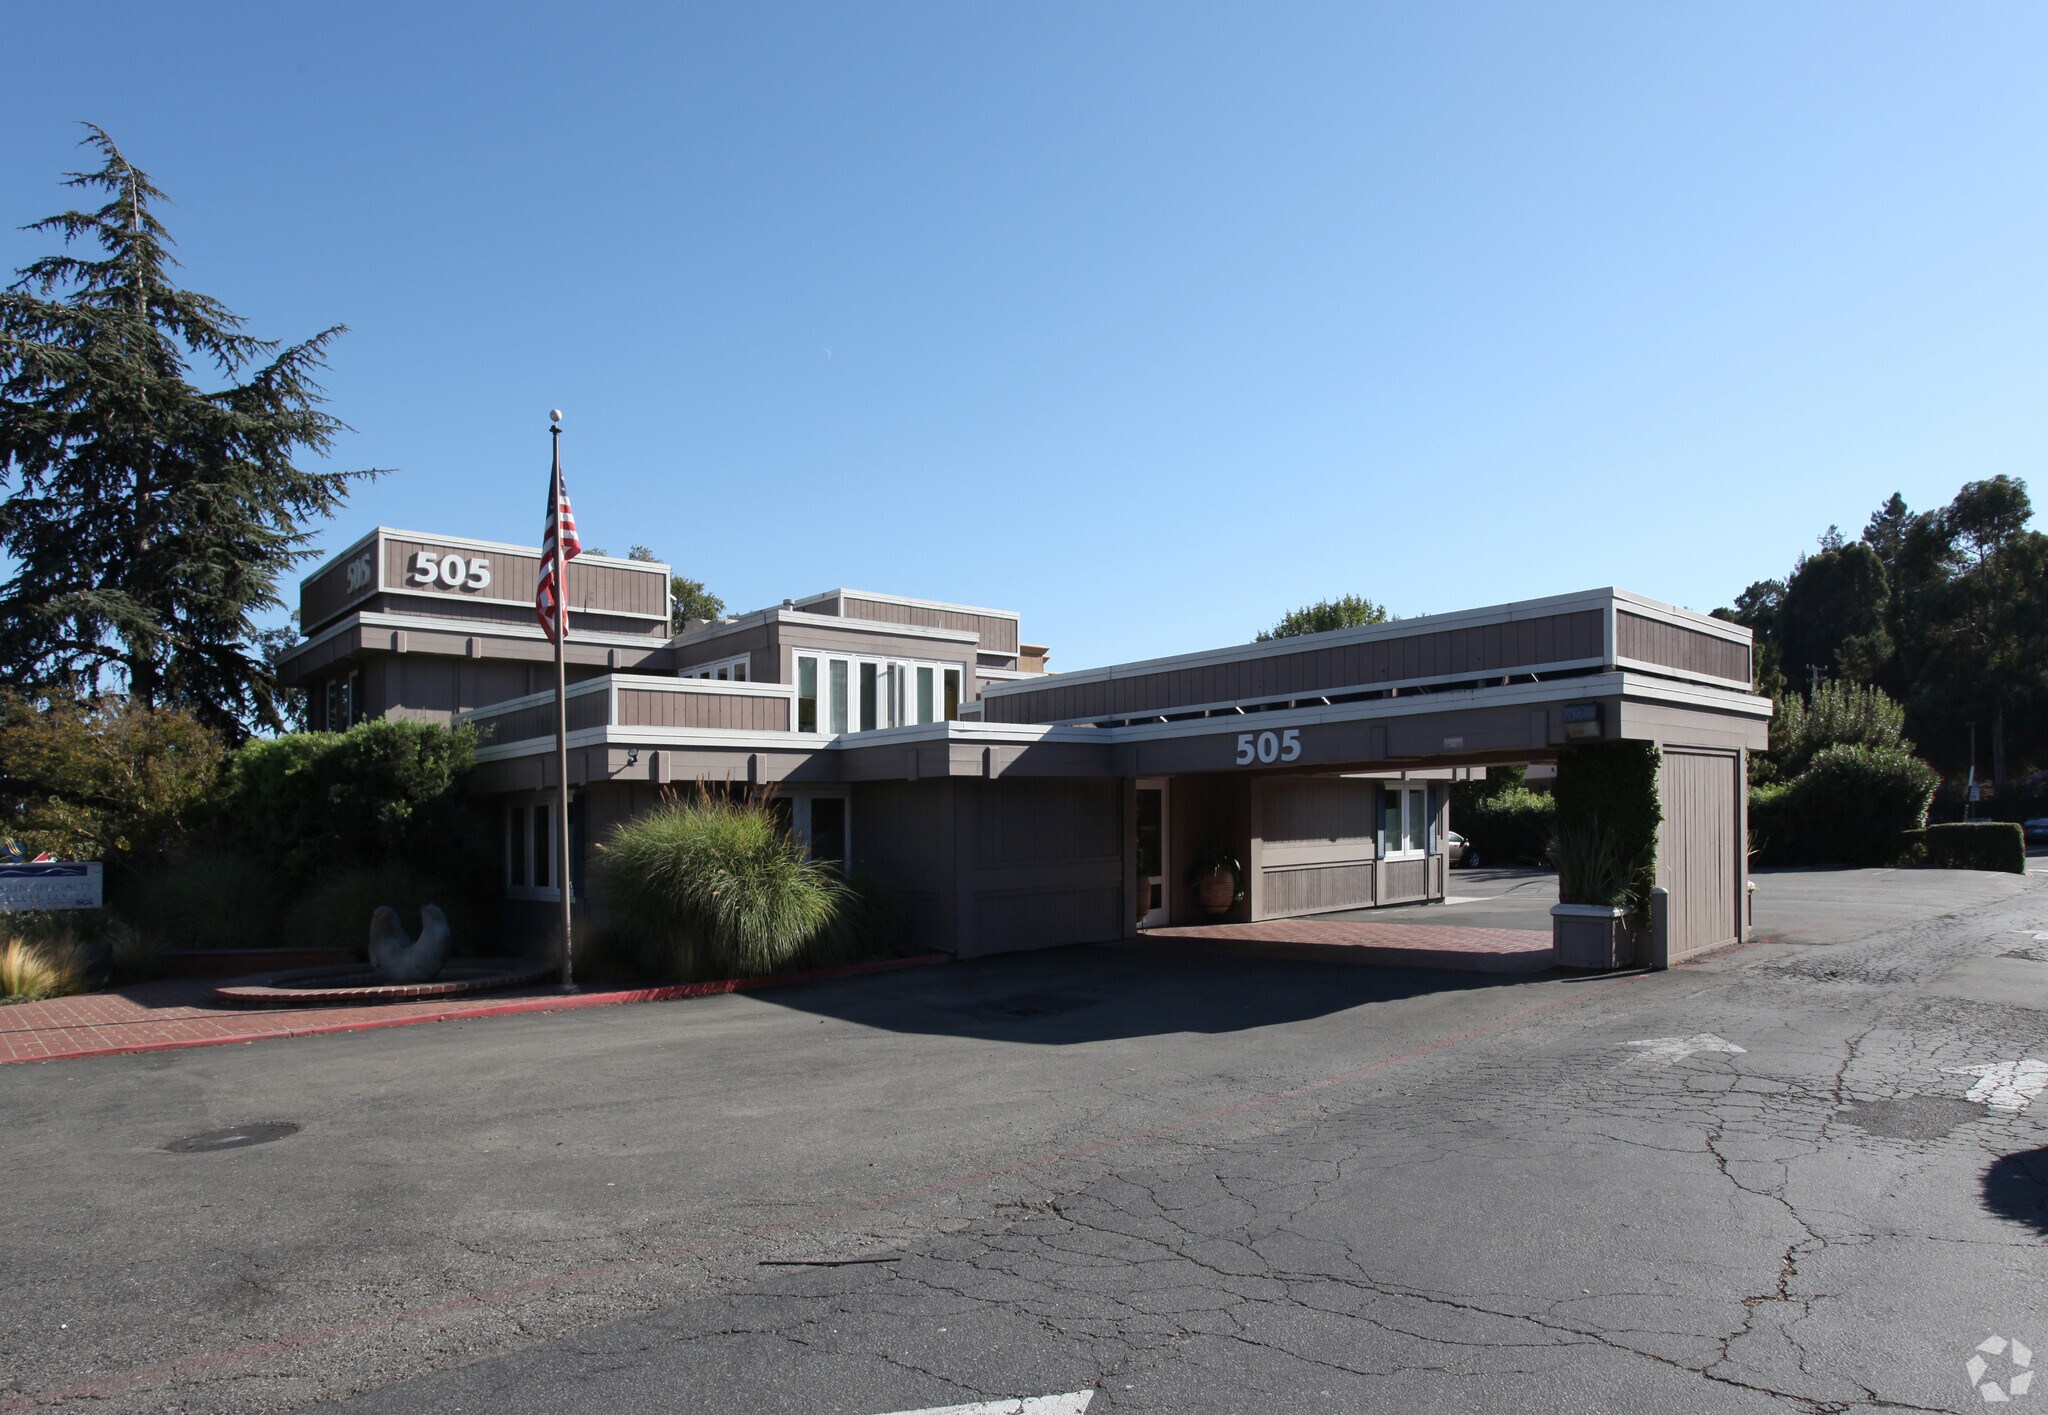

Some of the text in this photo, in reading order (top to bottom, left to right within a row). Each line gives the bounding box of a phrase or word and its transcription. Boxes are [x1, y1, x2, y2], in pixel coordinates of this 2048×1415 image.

[346, 553, 371, 593] 505
[414, 551, 491, 589] 505
[1236, 729, 1301, 765] 505
